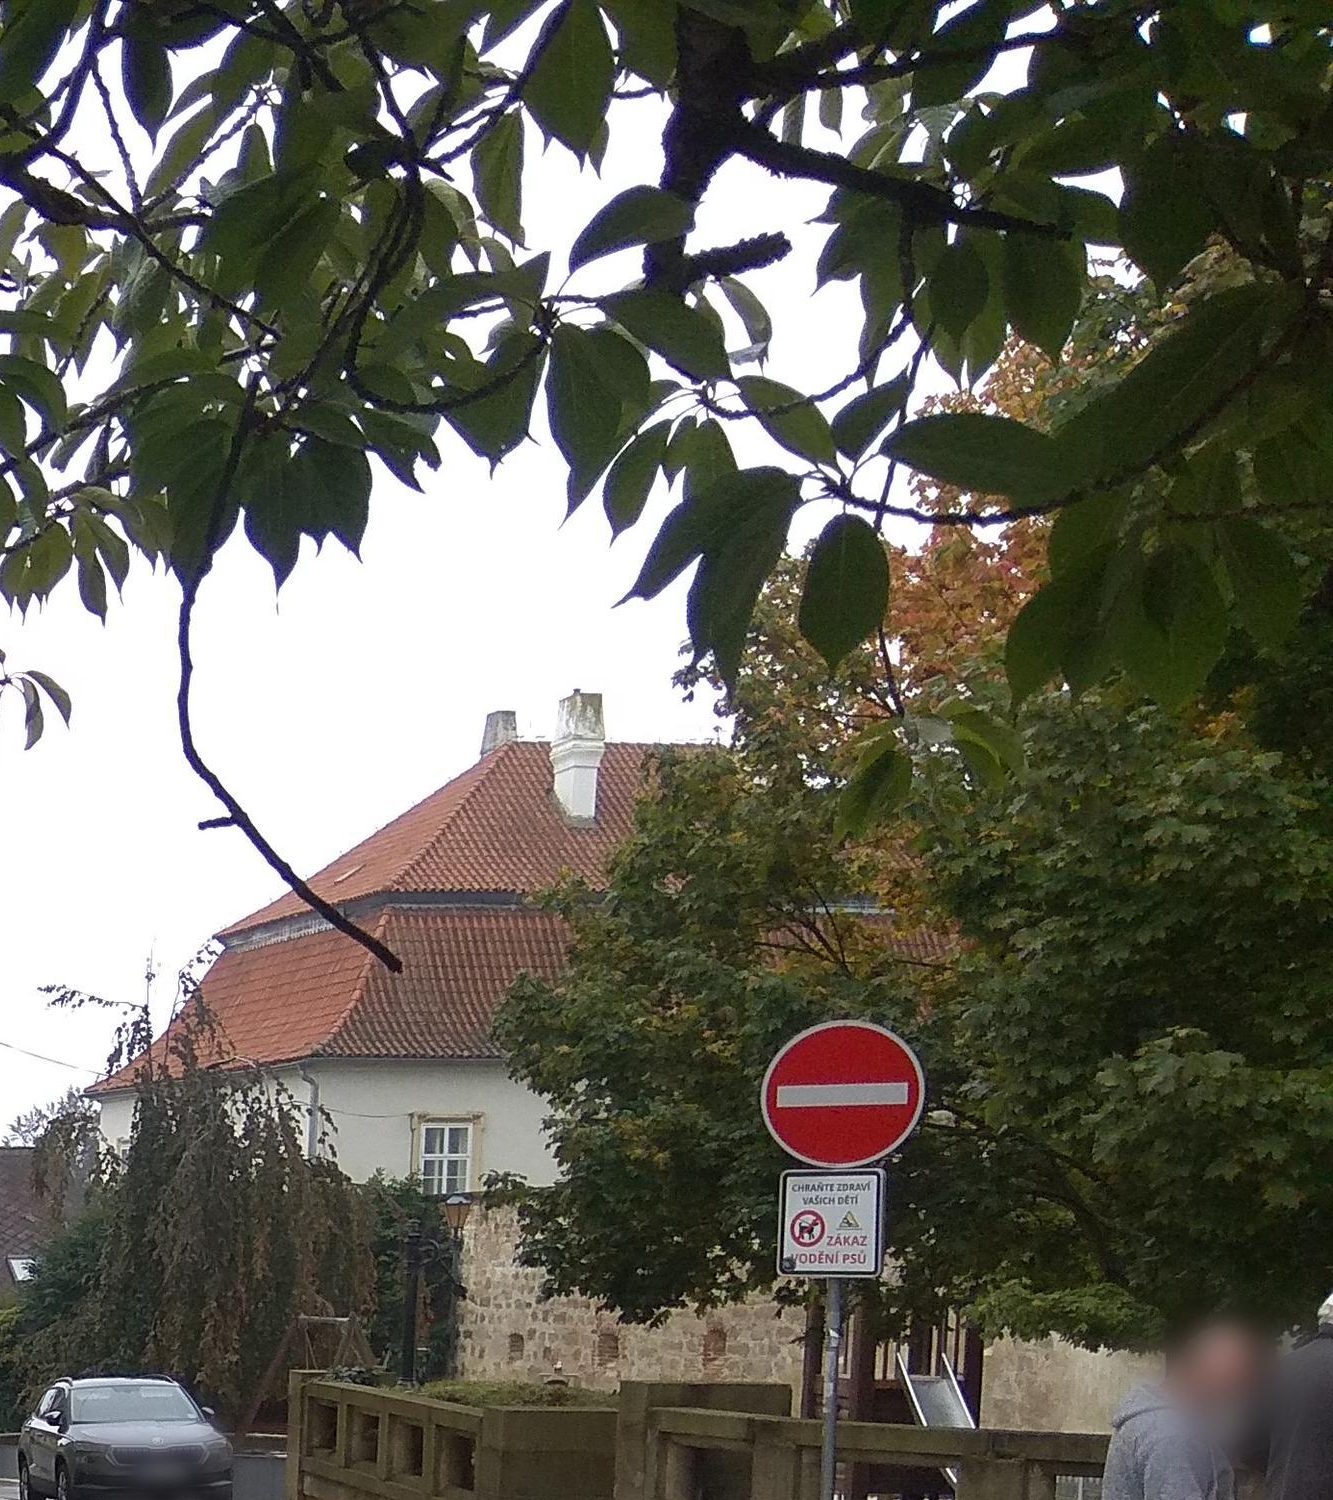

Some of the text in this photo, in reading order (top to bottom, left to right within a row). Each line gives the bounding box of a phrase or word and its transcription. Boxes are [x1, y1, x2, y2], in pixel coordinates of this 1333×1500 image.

[792, 1182, 870, 1192] CHRAŇTE ZDRAVÍ
[802, 1195, 858, 1205] VAŠICH DĚTÍ
[827, 1233, 867, 1246] ZÁKAZ
[791, 1251, 866, 1264] VODĚNÍ PSŮ
